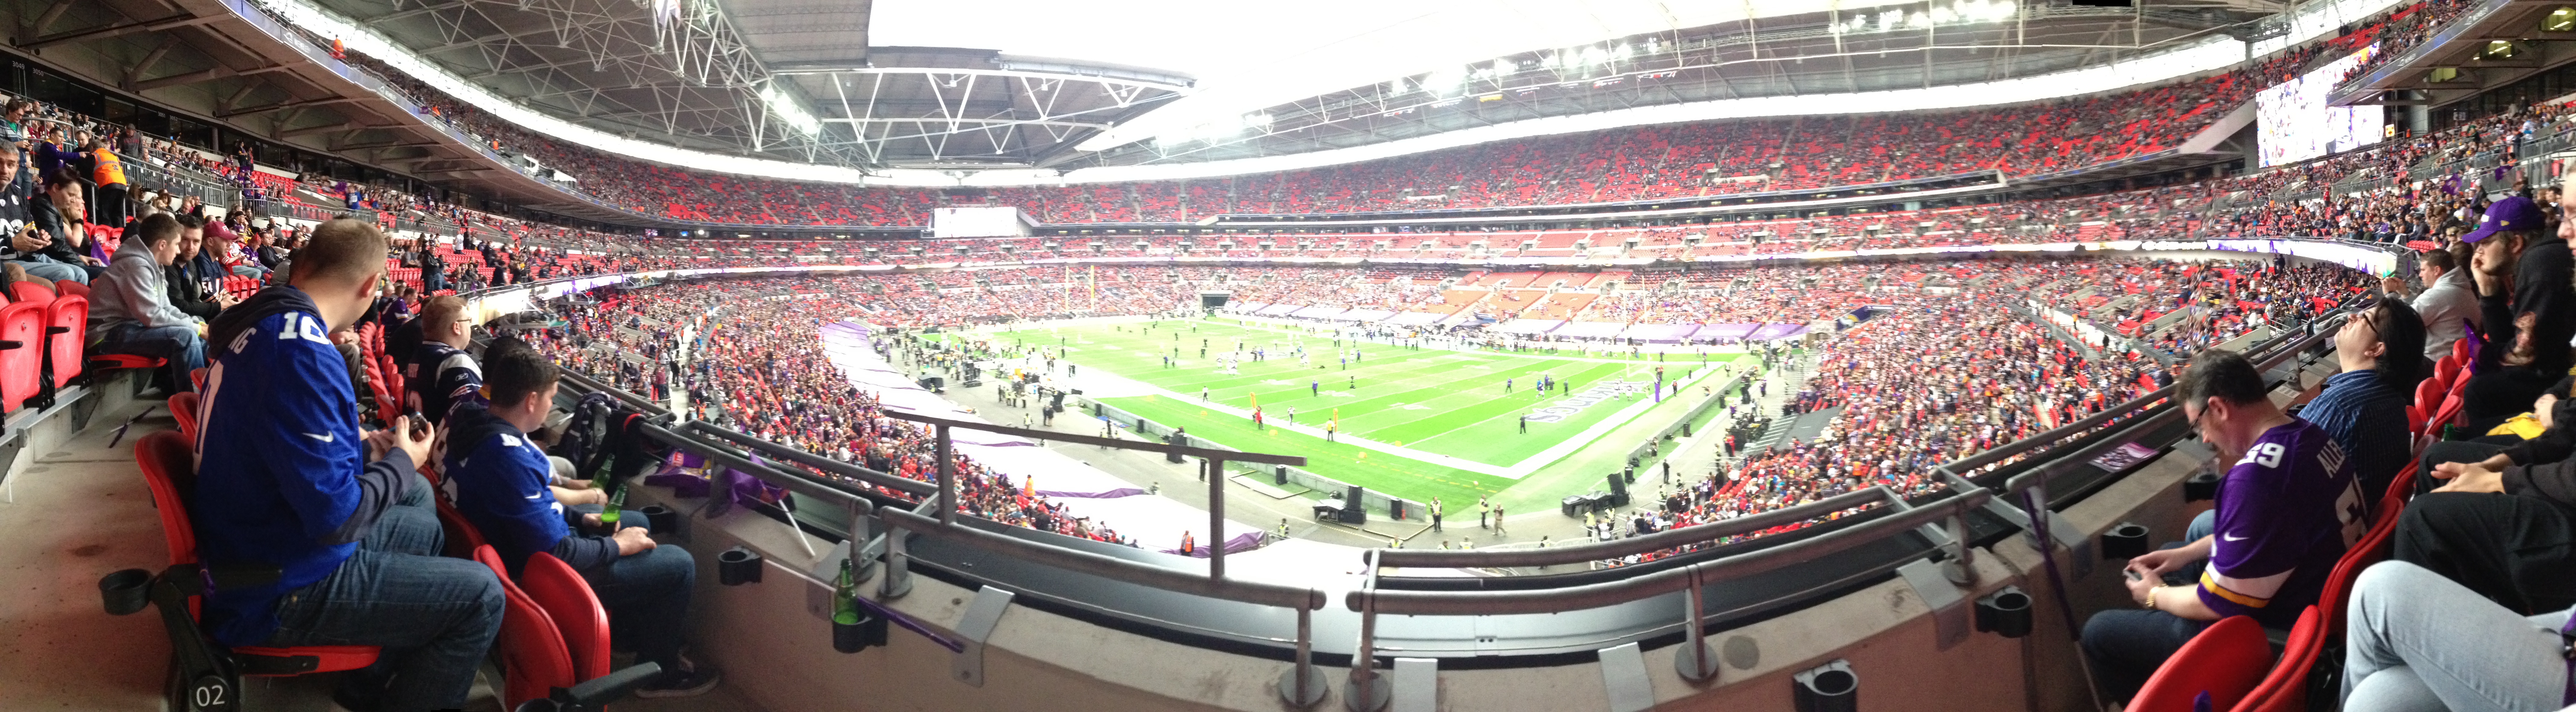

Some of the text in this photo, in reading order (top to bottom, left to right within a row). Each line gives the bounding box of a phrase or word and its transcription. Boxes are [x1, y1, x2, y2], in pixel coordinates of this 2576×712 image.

[12, 61, 24, 70] 3049
[32, 67, 44, 76] 3050
[202, 281, 213, 293] 54
[279, 312, 329, 344] 10
[196, 685, 225, 707] 02
